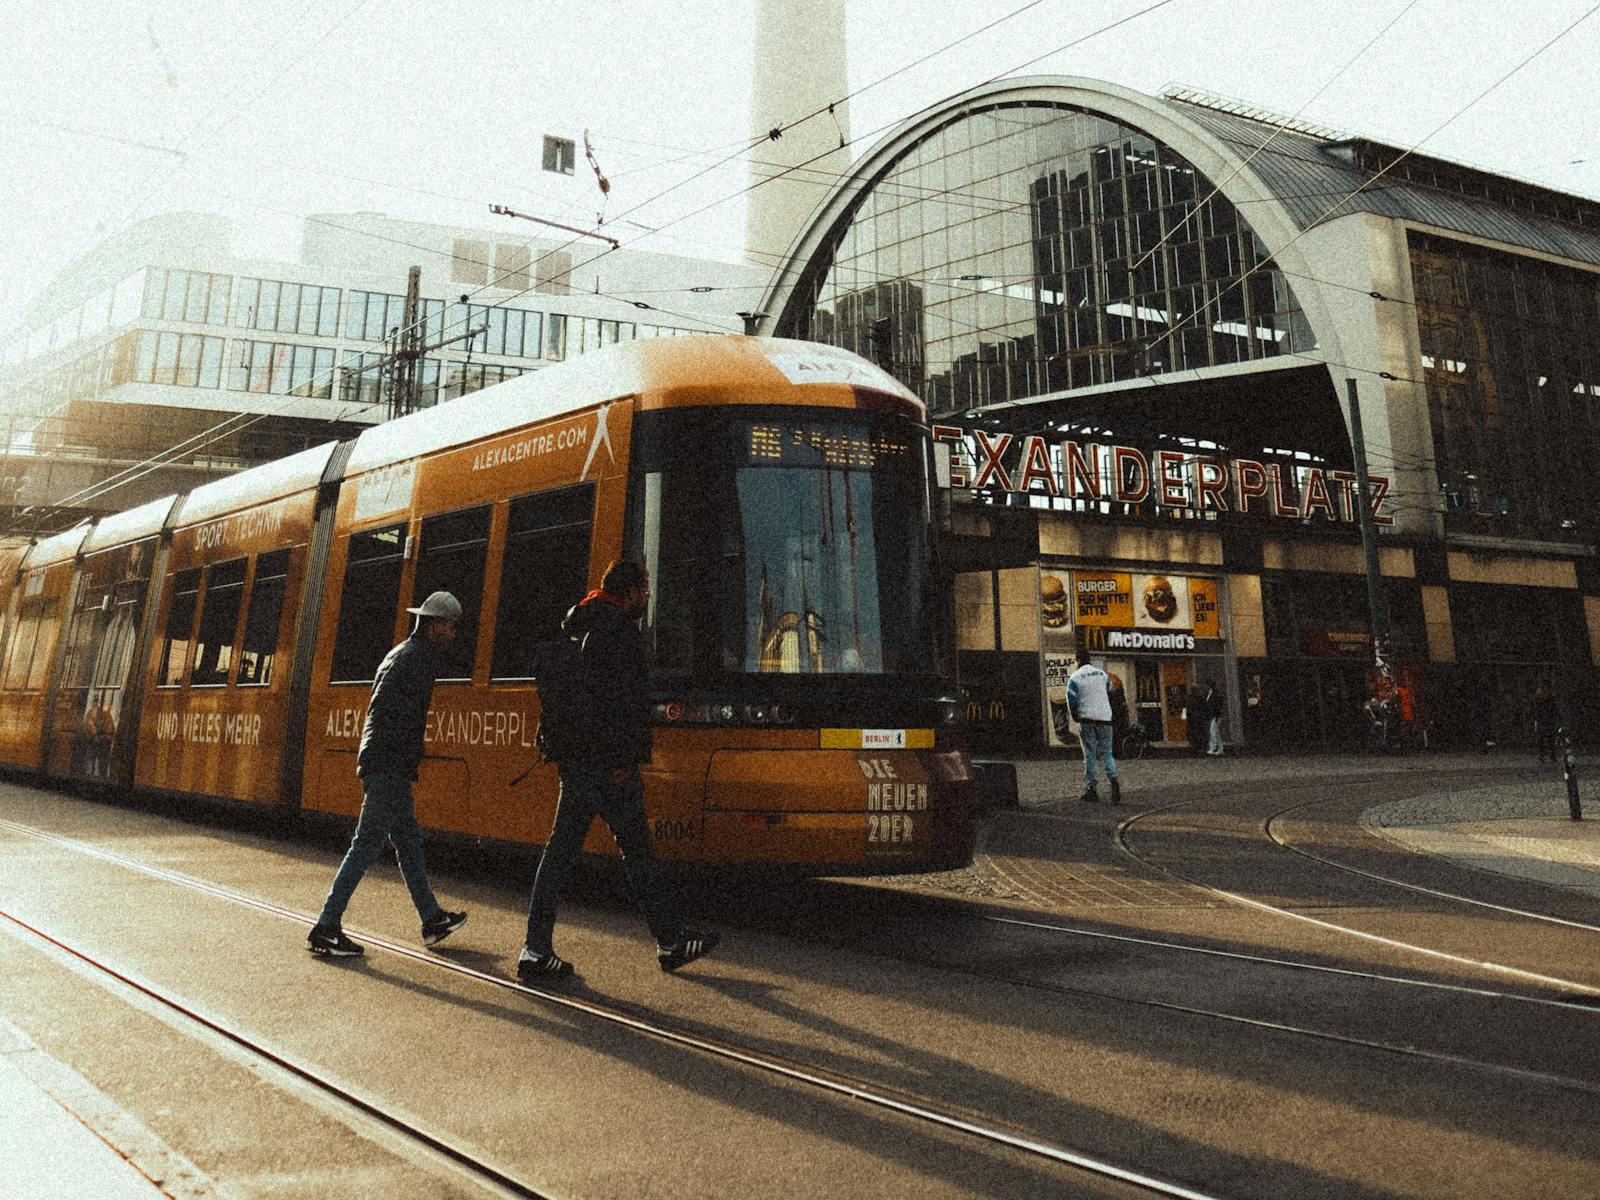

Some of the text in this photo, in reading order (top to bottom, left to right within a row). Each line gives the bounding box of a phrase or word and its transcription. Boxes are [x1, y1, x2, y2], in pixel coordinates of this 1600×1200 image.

[472, 425, 588, 472] ALEXACENTRE.COM
[932, 424, 1396, 526] EXANDERPLATZ
[1078, 580, 1117, 592] BURGER
[1108, 630, 1195, 650] McDonald's
[156, 711, 261, 745] UND VIELES MEHR
[325, 708, 541, 748] ALEX EXANDERPL
[865, 734, 890, 743] BERLIN
[858, 759, 897, 778] DIE
[868, 783, 928, 811] NEUEN
[655, 819, 696, 842] 8004
[868, 814, 914, 842] 20ER
